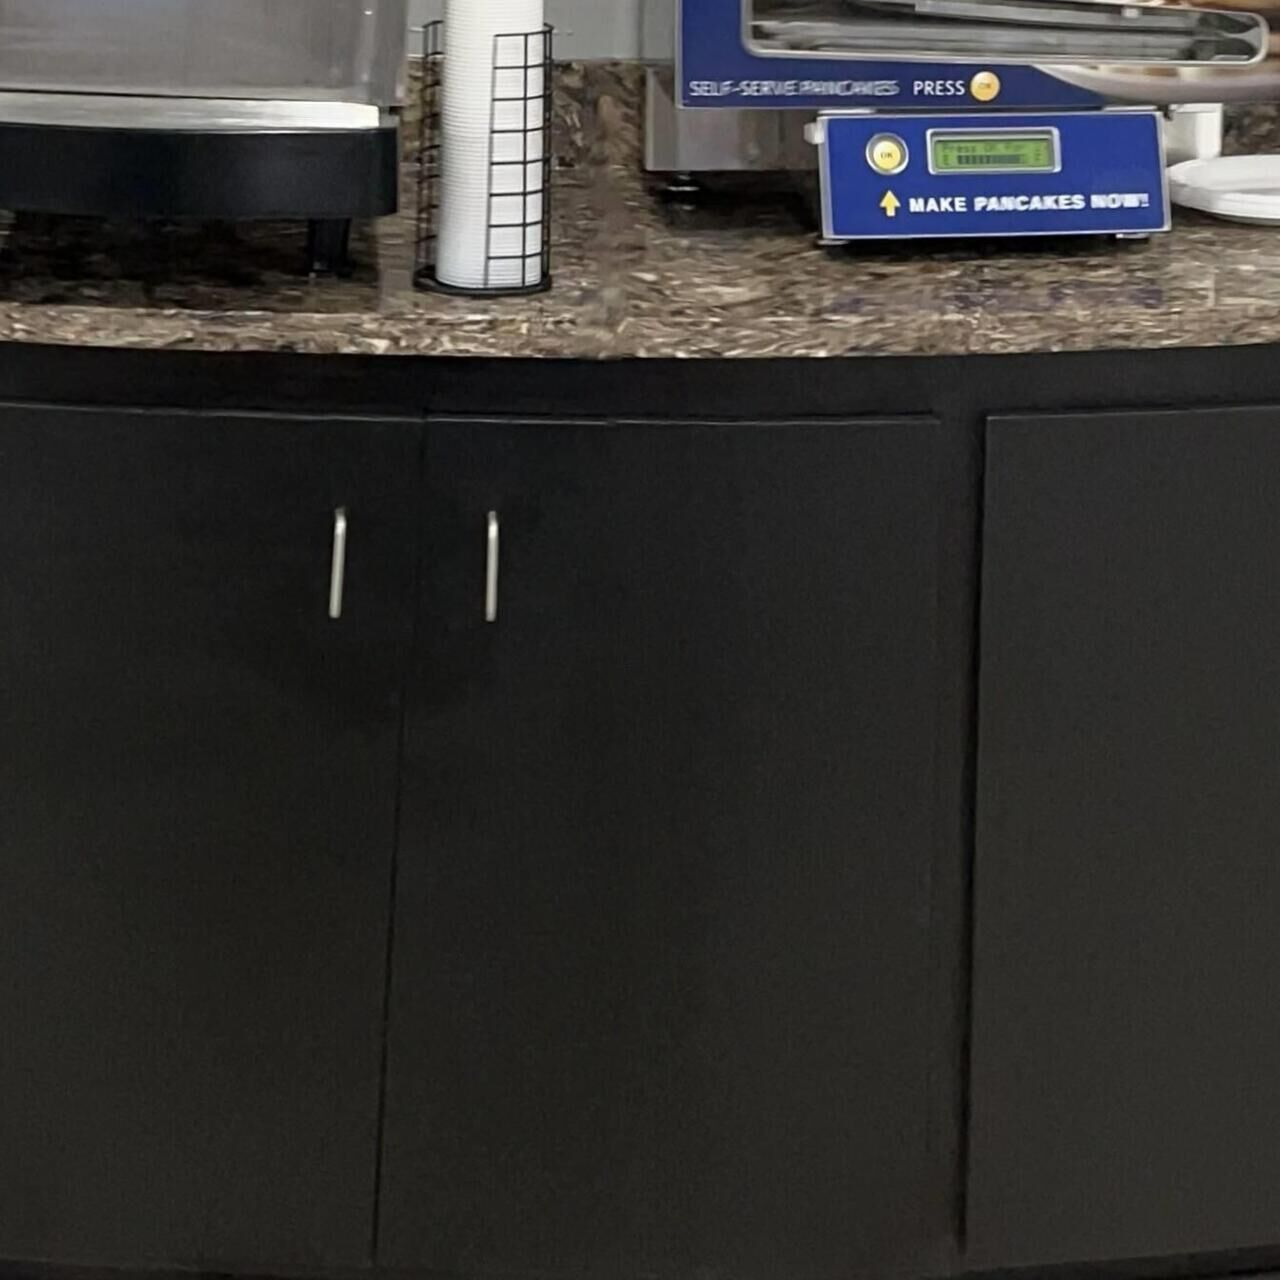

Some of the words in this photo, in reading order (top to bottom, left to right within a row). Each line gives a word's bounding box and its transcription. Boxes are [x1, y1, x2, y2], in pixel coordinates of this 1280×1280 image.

[689, 79, 799, 97] SELF-SERVE
[800, 79, 900, 96] PANCAKES
[913, 80, 966, 96] PRESS
[880, 151, 893, 160] OK
[908, 196, 968, 213] MAKE
[973, 194, 1086, 212] PANCAKES
[1090, 193, 1150, 209] NOW!
